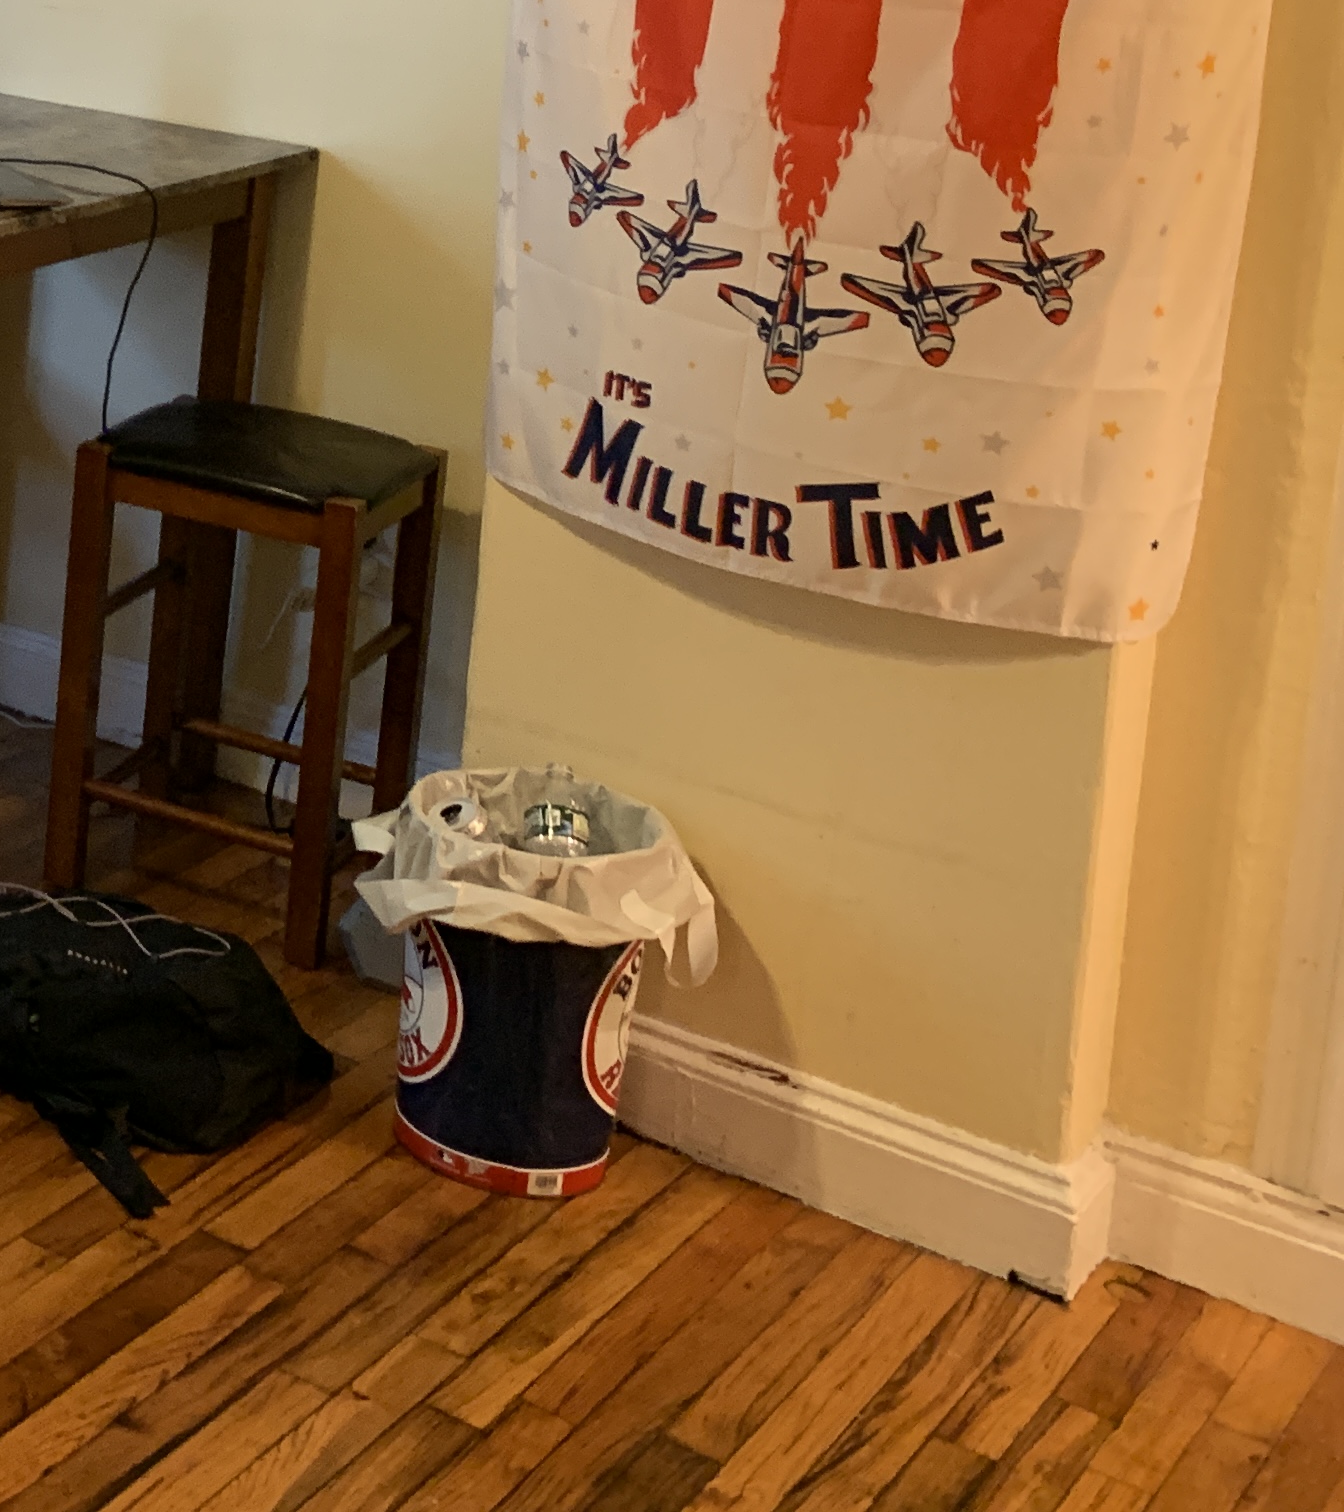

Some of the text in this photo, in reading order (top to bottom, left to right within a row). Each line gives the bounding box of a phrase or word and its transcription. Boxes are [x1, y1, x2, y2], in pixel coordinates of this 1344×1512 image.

[602, 370, 652, 408] IT'S
[561, 396, 1004, 571] MILLER TIME
